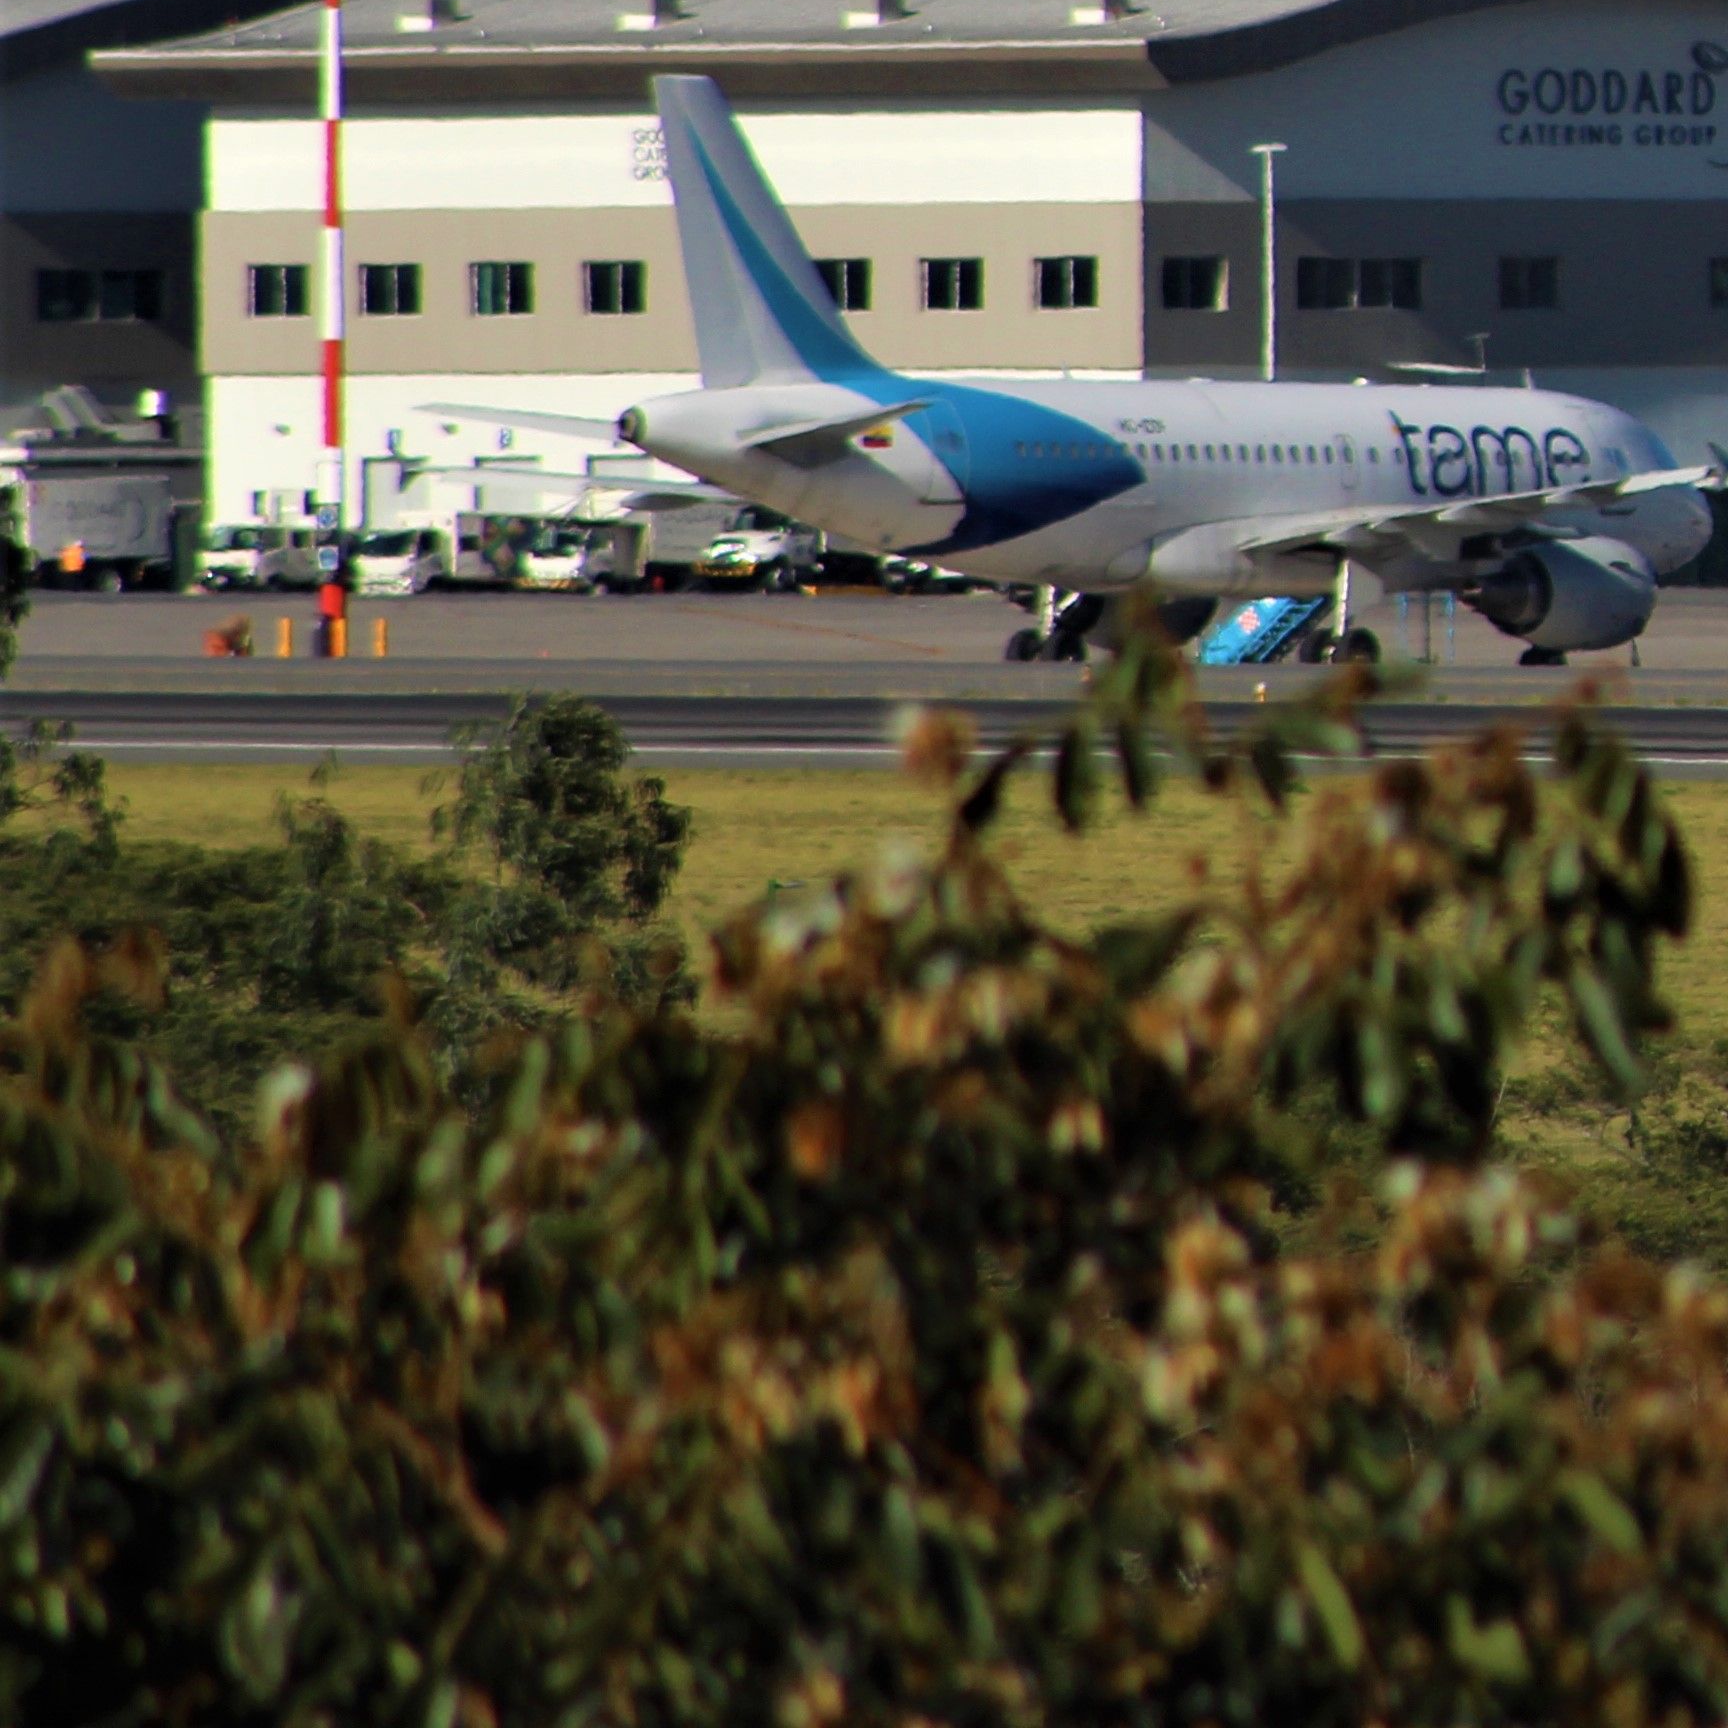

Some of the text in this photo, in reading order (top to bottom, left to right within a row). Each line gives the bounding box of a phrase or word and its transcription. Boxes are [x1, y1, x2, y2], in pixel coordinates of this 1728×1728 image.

[1498, 68, 1716, 116] GODDARD
[1500, 123, 1717, 146] CATERING GROUP
[1388, 408, 1592, 496] tame
